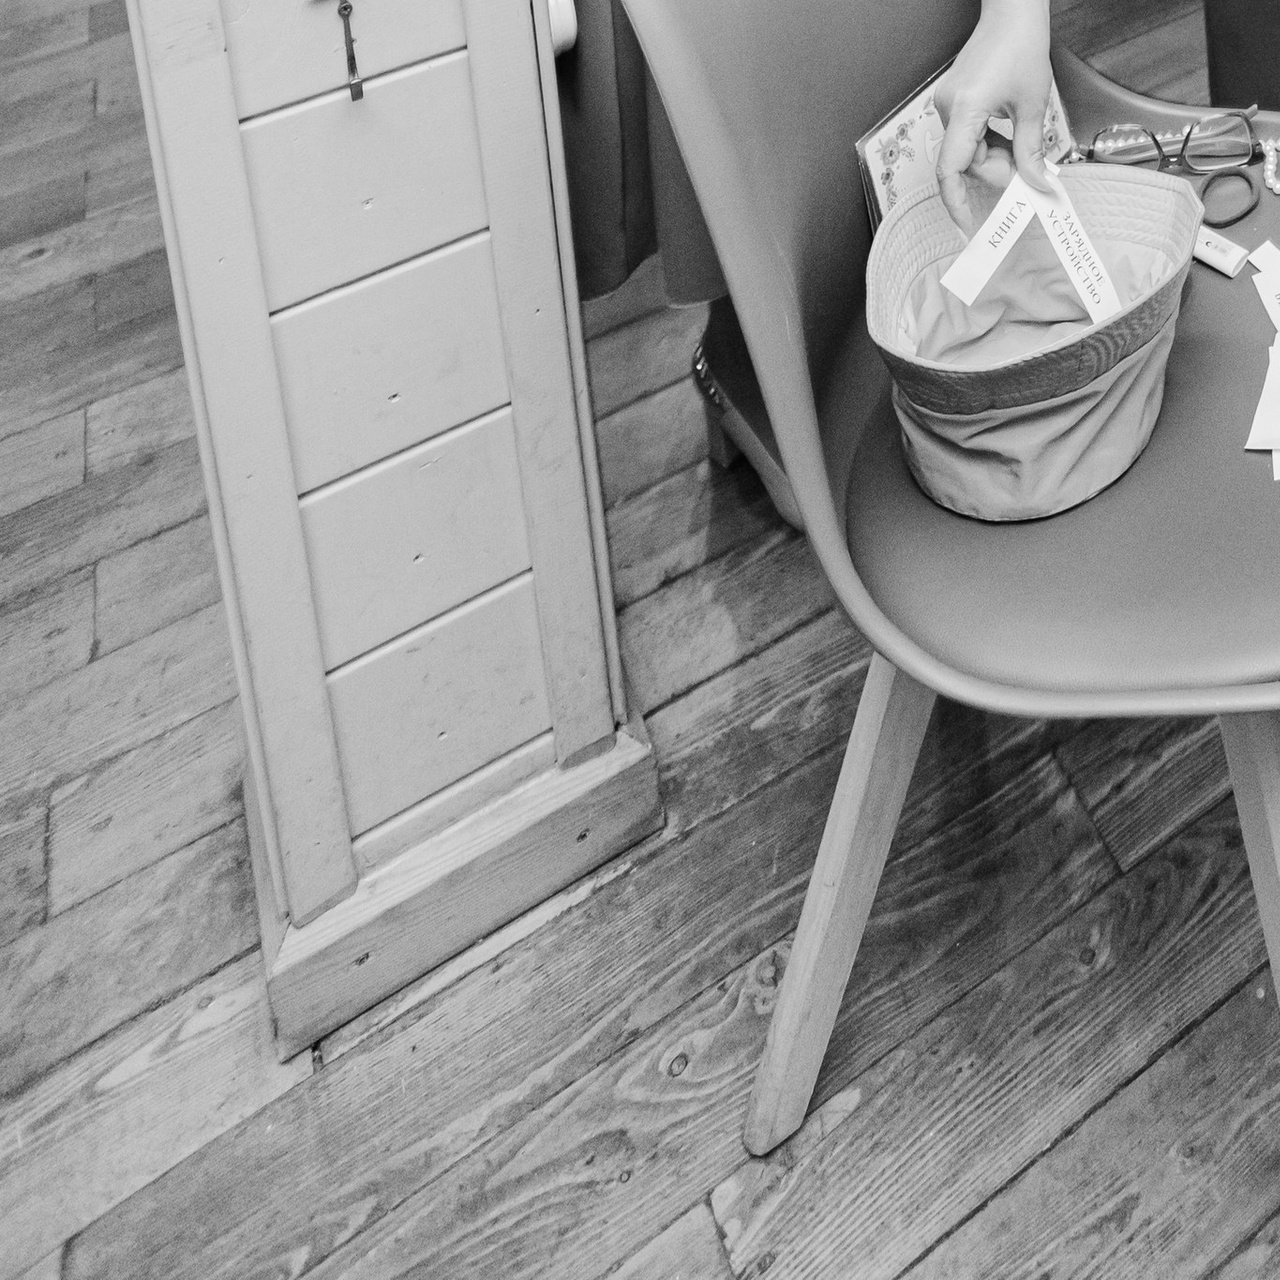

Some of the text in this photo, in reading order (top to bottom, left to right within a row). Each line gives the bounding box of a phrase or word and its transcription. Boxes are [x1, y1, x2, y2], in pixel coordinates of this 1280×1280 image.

[988, 200, 1027, 248] КНИГА
[1047, 209, 1101, 305] УСТРОЙСТВО
[1063, 210, 1106, 287] ЗАРЯДНОЕ
